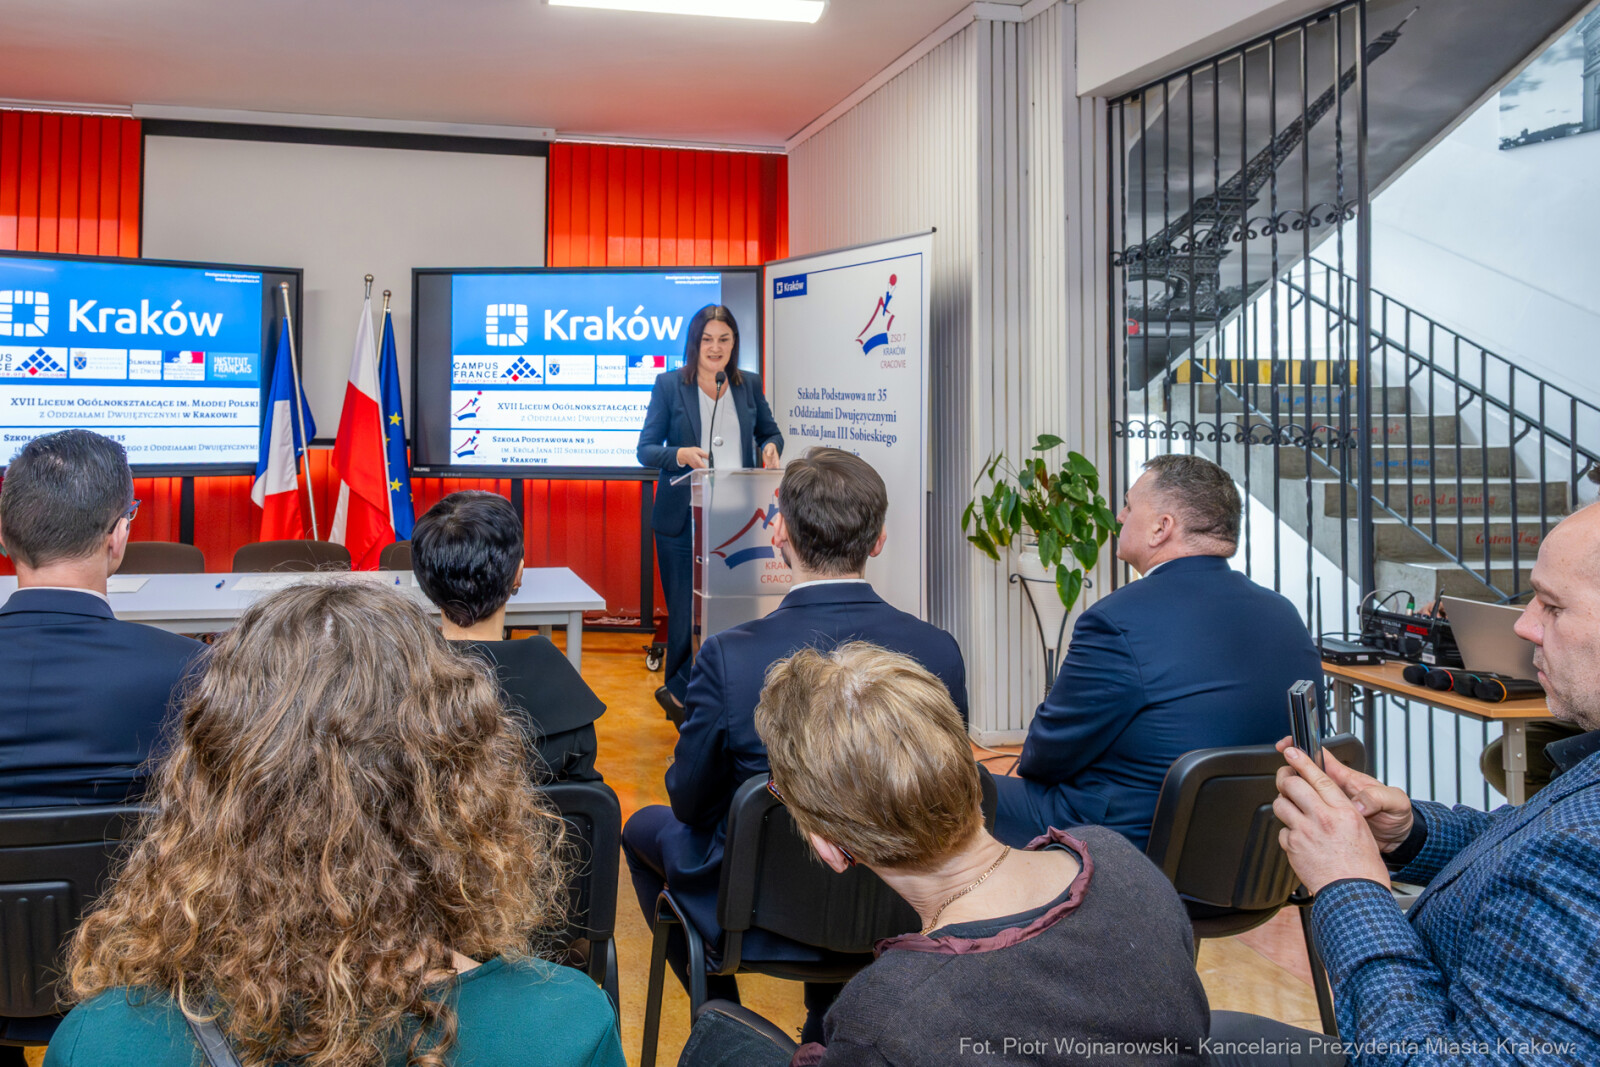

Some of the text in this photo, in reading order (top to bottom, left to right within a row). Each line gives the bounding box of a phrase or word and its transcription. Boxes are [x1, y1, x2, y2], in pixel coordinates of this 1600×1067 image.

[784, 280, 804, 292] Kraków
[69, 299, 223, 337] Kraków
[544, 304, 684, 341] Kraków
[883, 346, 906, 356] KRAKÓW
[453, 362, 498, 370] CAMPUS
[880, 360, 906, 369] CRACOVIE
[797, 387, 887, 401] Szkoła Podstawowa nr 35
[10, 398, 35, 406] XVII
[497, 402, 518, 410] XVII
[794, 405, 834, 420] Oddziałami
[835, 407, 897, 426] Dwujęzycznymi
[789, 424, 897, 447] im. Króla Jana III Sobieskiego
[760, 574, 792, 583] CRACO
